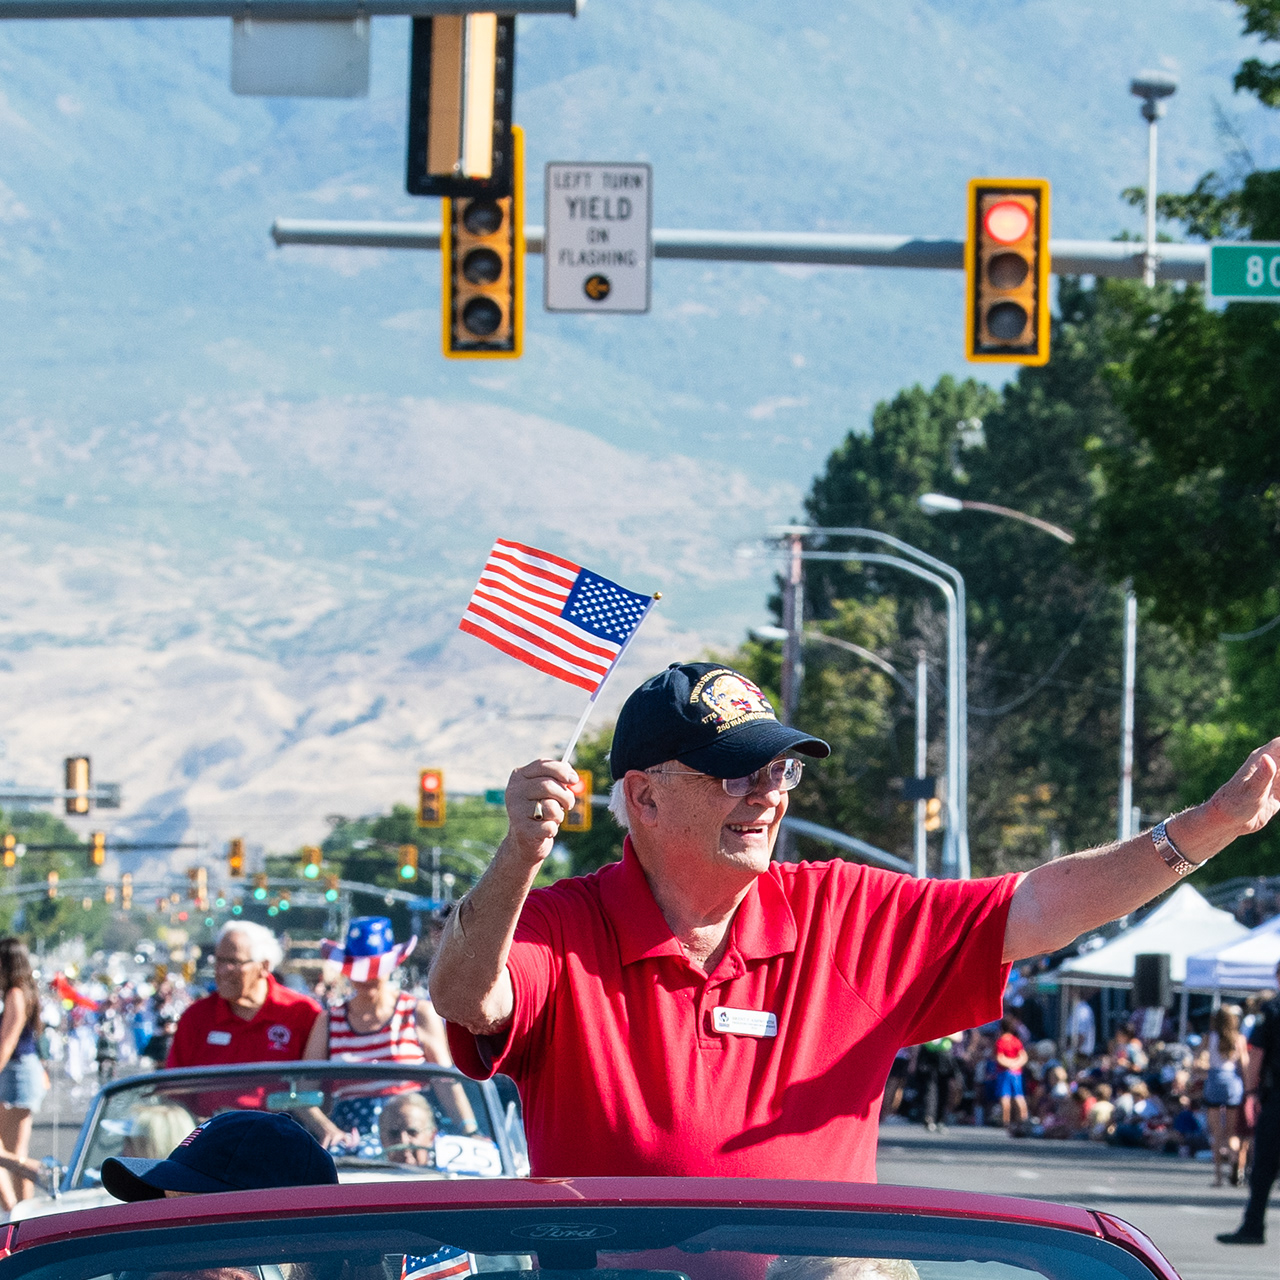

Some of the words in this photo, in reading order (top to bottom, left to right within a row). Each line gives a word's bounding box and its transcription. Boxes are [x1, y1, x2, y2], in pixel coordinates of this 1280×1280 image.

[566, 196, 633, 220] YIELD
[558, 249, 637, 268] FLASHING
[445, 1141, 492, 1168] 25
[529, 1225, 599, 1238] Ford
